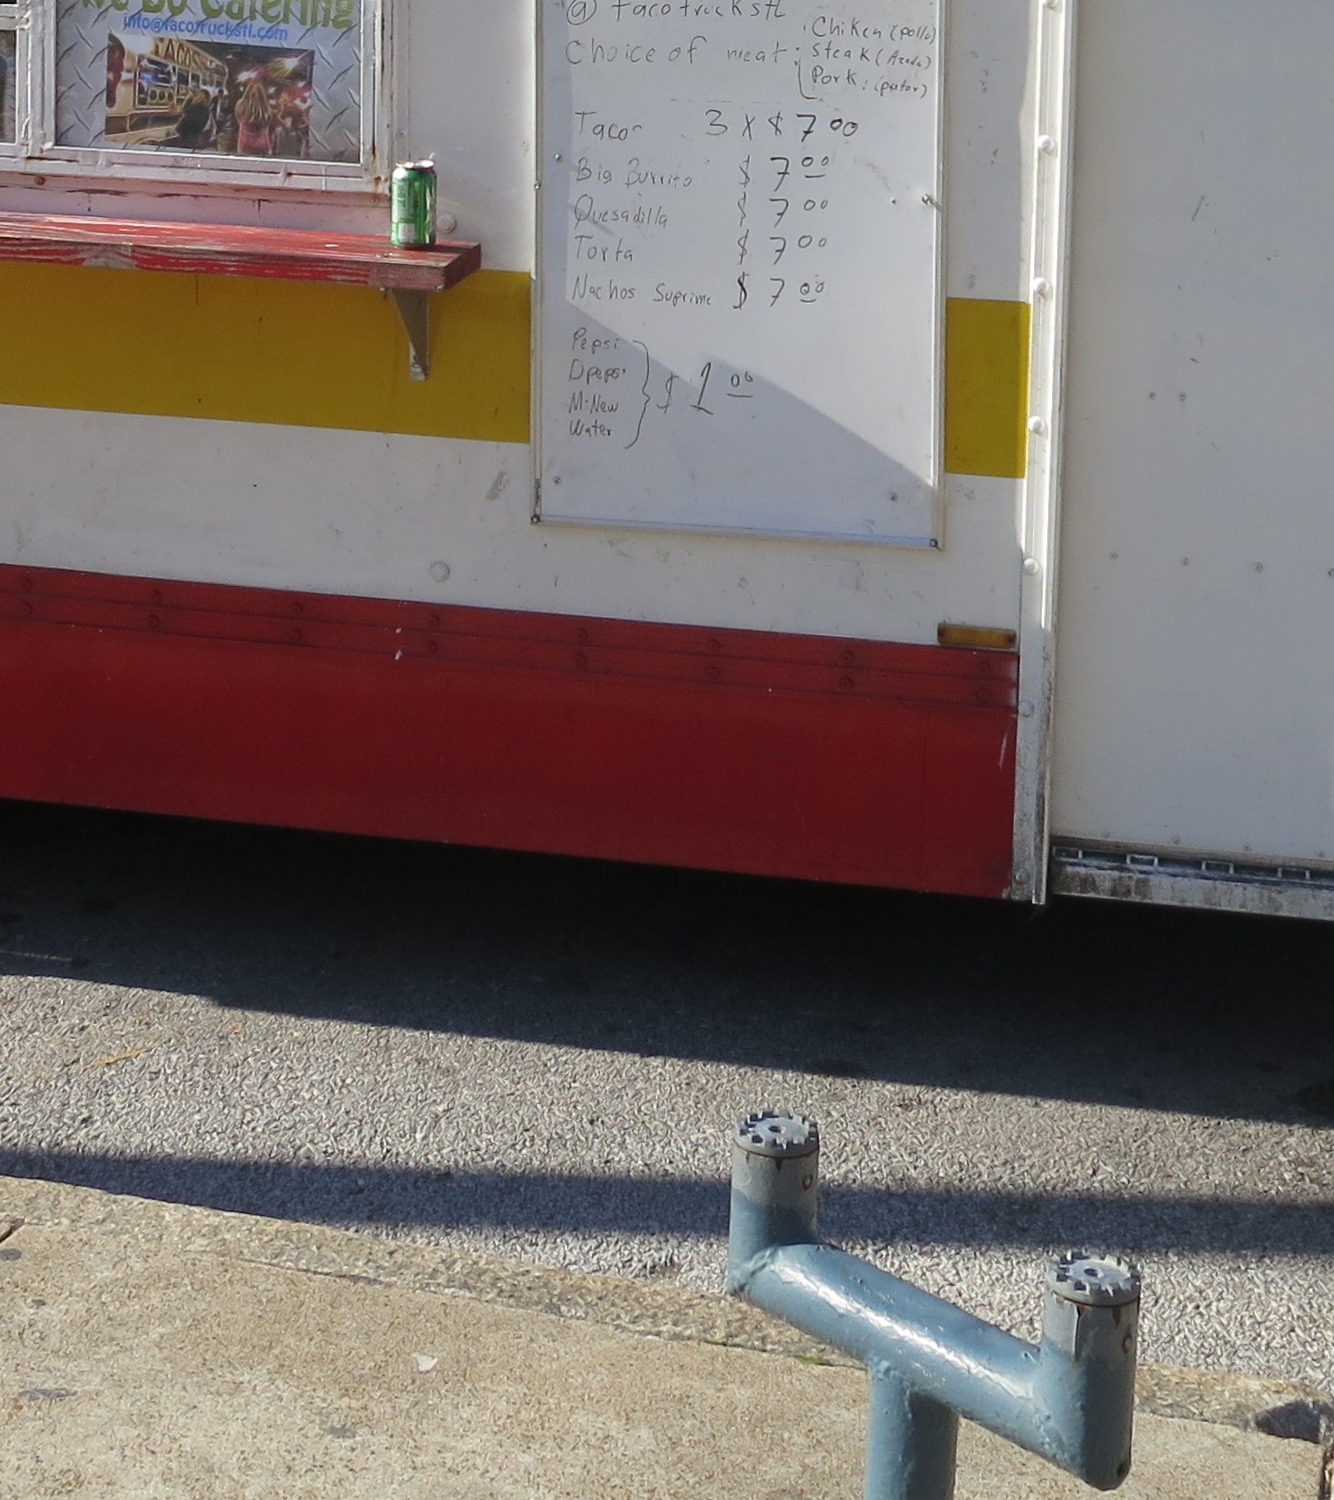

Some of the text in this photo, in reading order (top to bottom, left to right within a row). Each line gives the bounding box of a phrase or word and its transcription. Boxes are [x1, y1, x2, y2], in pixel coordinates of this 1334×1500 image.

[123, 13, 288, 41] info@tacotruckstl.com
[565, 37, 656, 65] Choice
[667, 35, 708, 64] of
[704, 109, 729, 136] 3
[575, 157, 613, 183] Big
[573, 193, 668, 229] Quesadilla
[574, 234, 634, 263] Torta
[571, 273, 637, 301] Nachos
[571, 327, 620, 355] Pepsi
[569, 419, 612, 438] Water
